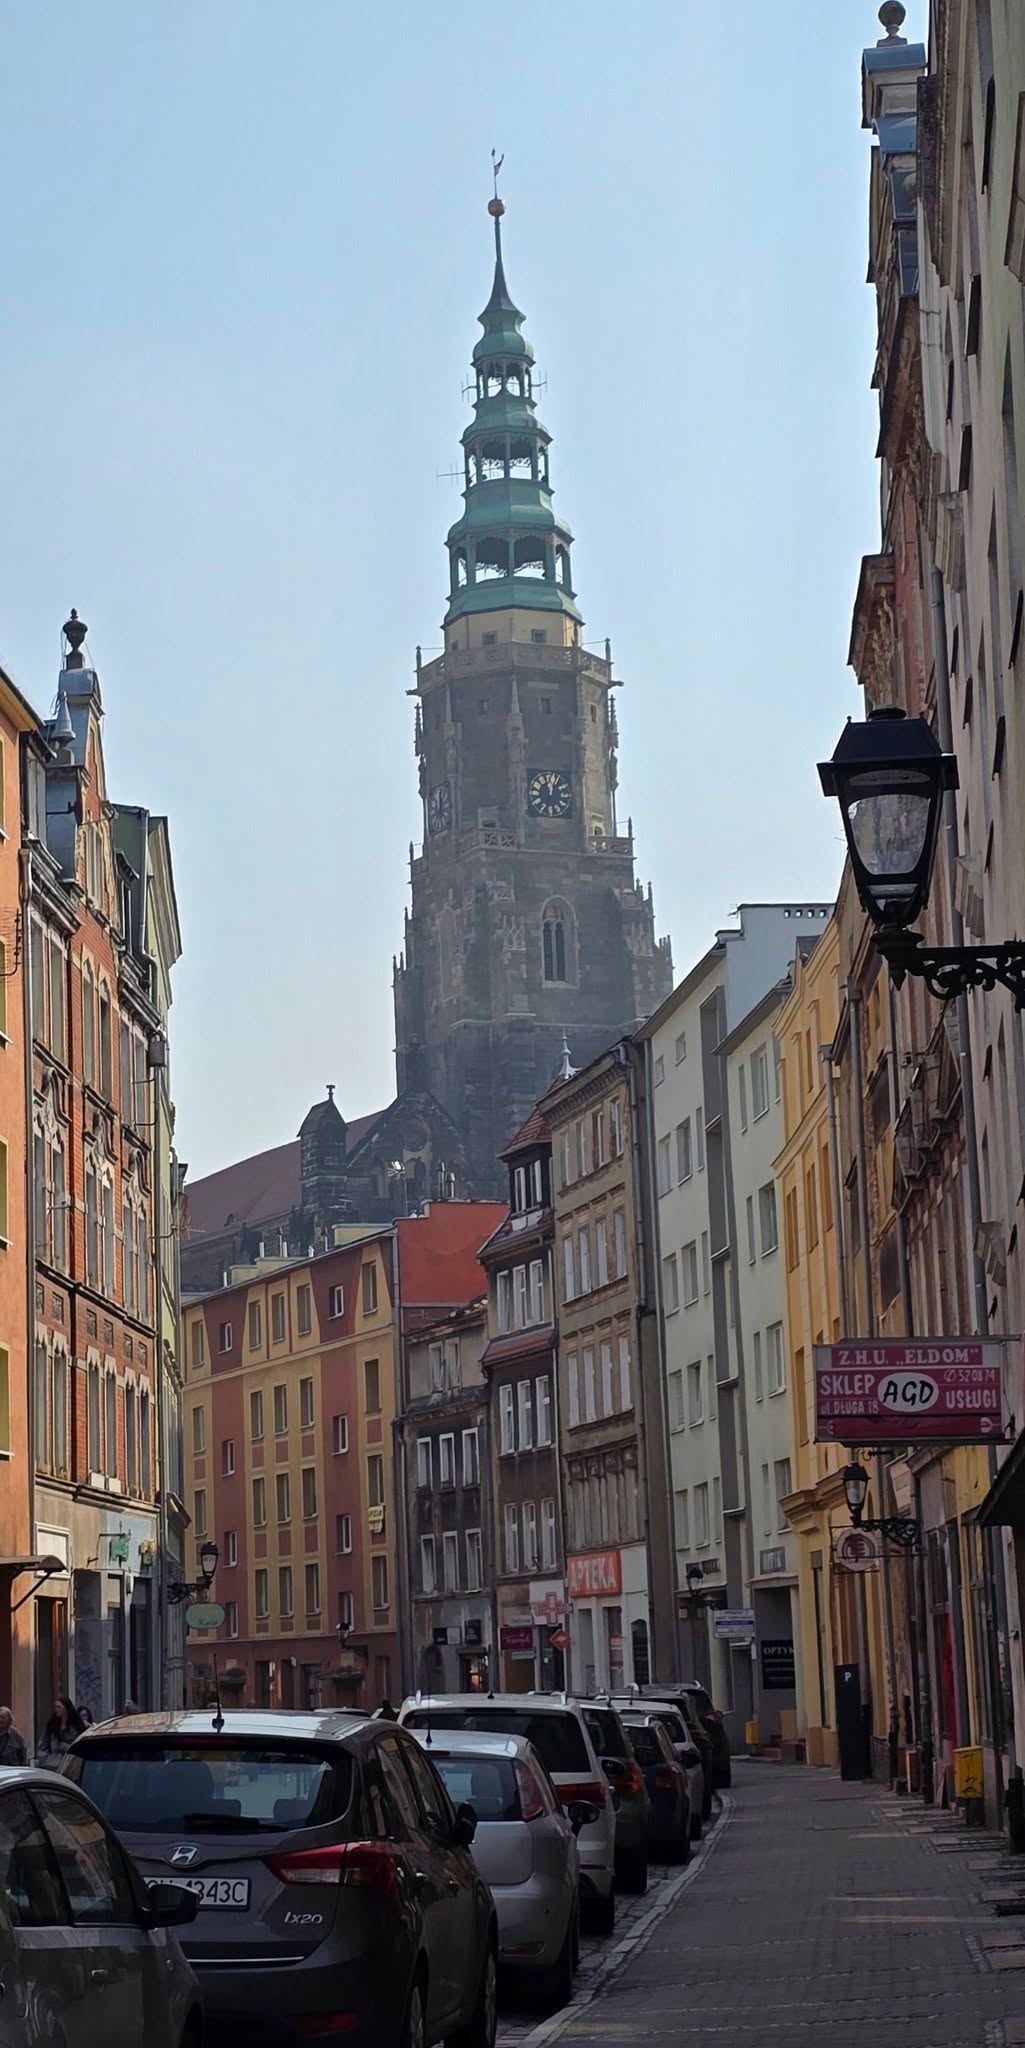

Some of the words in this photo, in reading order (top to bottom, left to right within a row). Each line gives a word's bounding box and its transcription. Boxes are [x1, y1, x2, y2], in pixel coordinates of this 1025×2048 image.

[838, 1350, 889, 1366] Z.H.U.
[820, 1374, 876, 1396] SKLEP
[882, 1380, 934, 1406] AGD
[834, 1401, 865, 1415] DŁUGA
[868, 1401, 880, 1414] 18
[945, 1389, 997, 1409] USŁUGI
[568, 1556, 617, 1592] APTEKA
[844, 1671, 852, 1682] P
